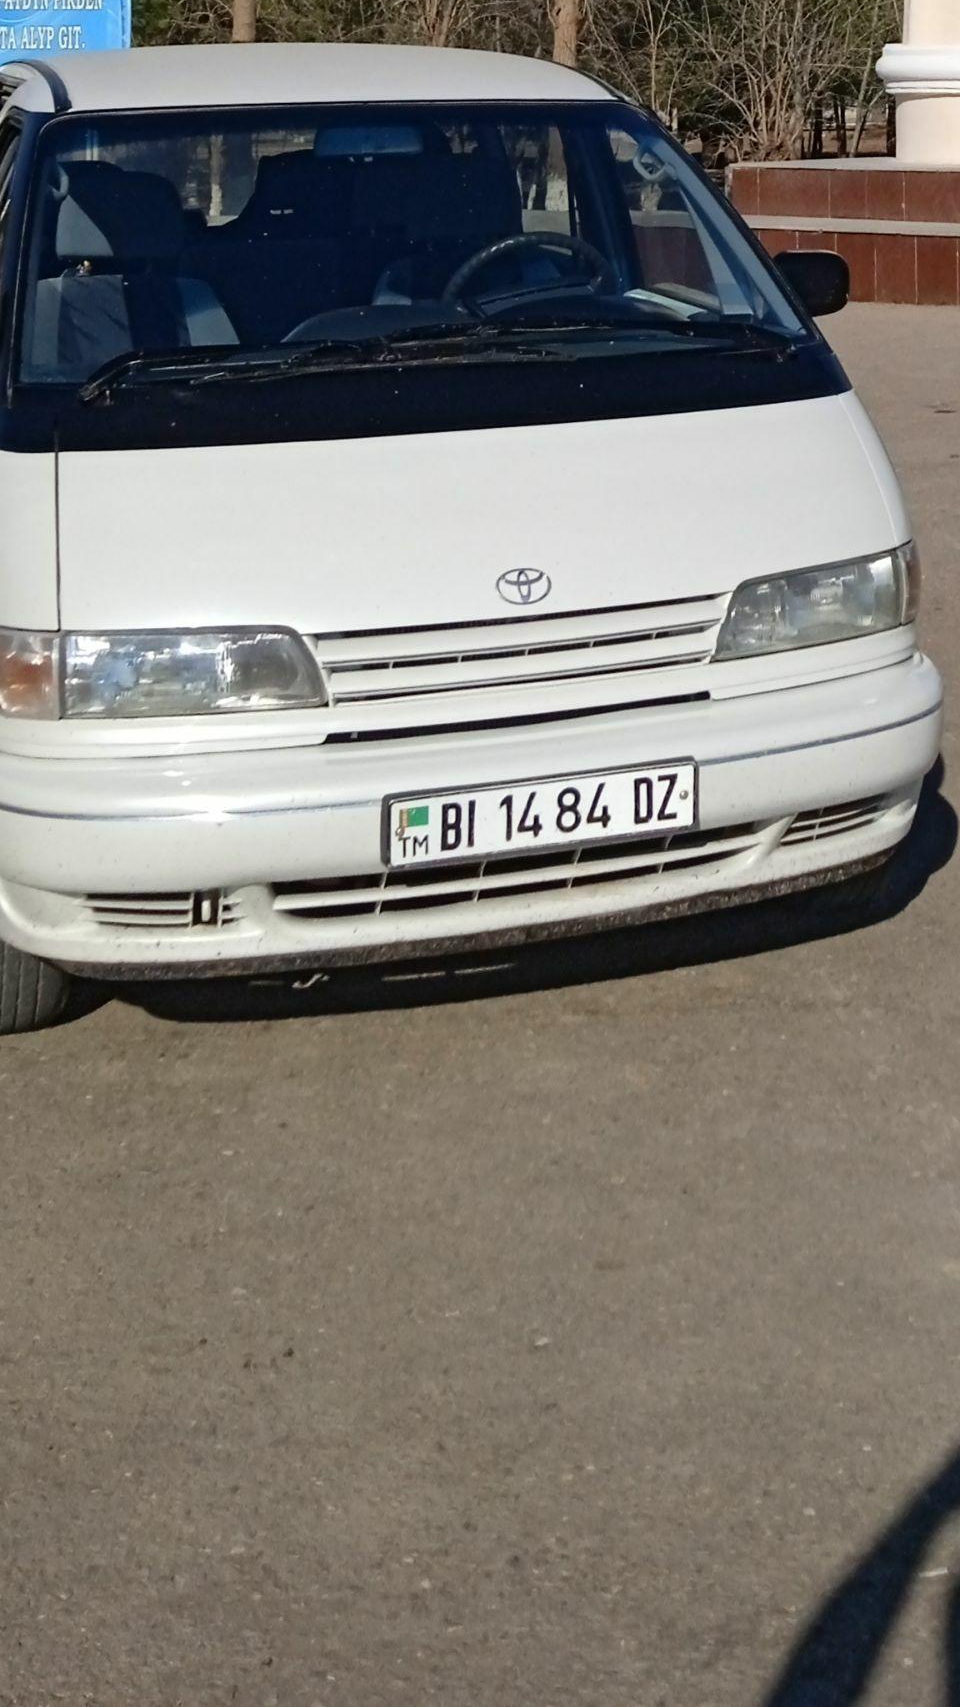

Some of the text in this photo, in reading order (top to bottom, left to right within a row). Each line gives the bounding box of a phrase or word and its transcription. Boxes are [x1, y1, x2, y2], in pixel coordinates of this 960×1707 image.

[21, 26, 54, 49] ALYP
[59, 26, 85, 49] GIT.
[634, 773, 678, 825] DZ
[400, 834, 429, 858] TM
